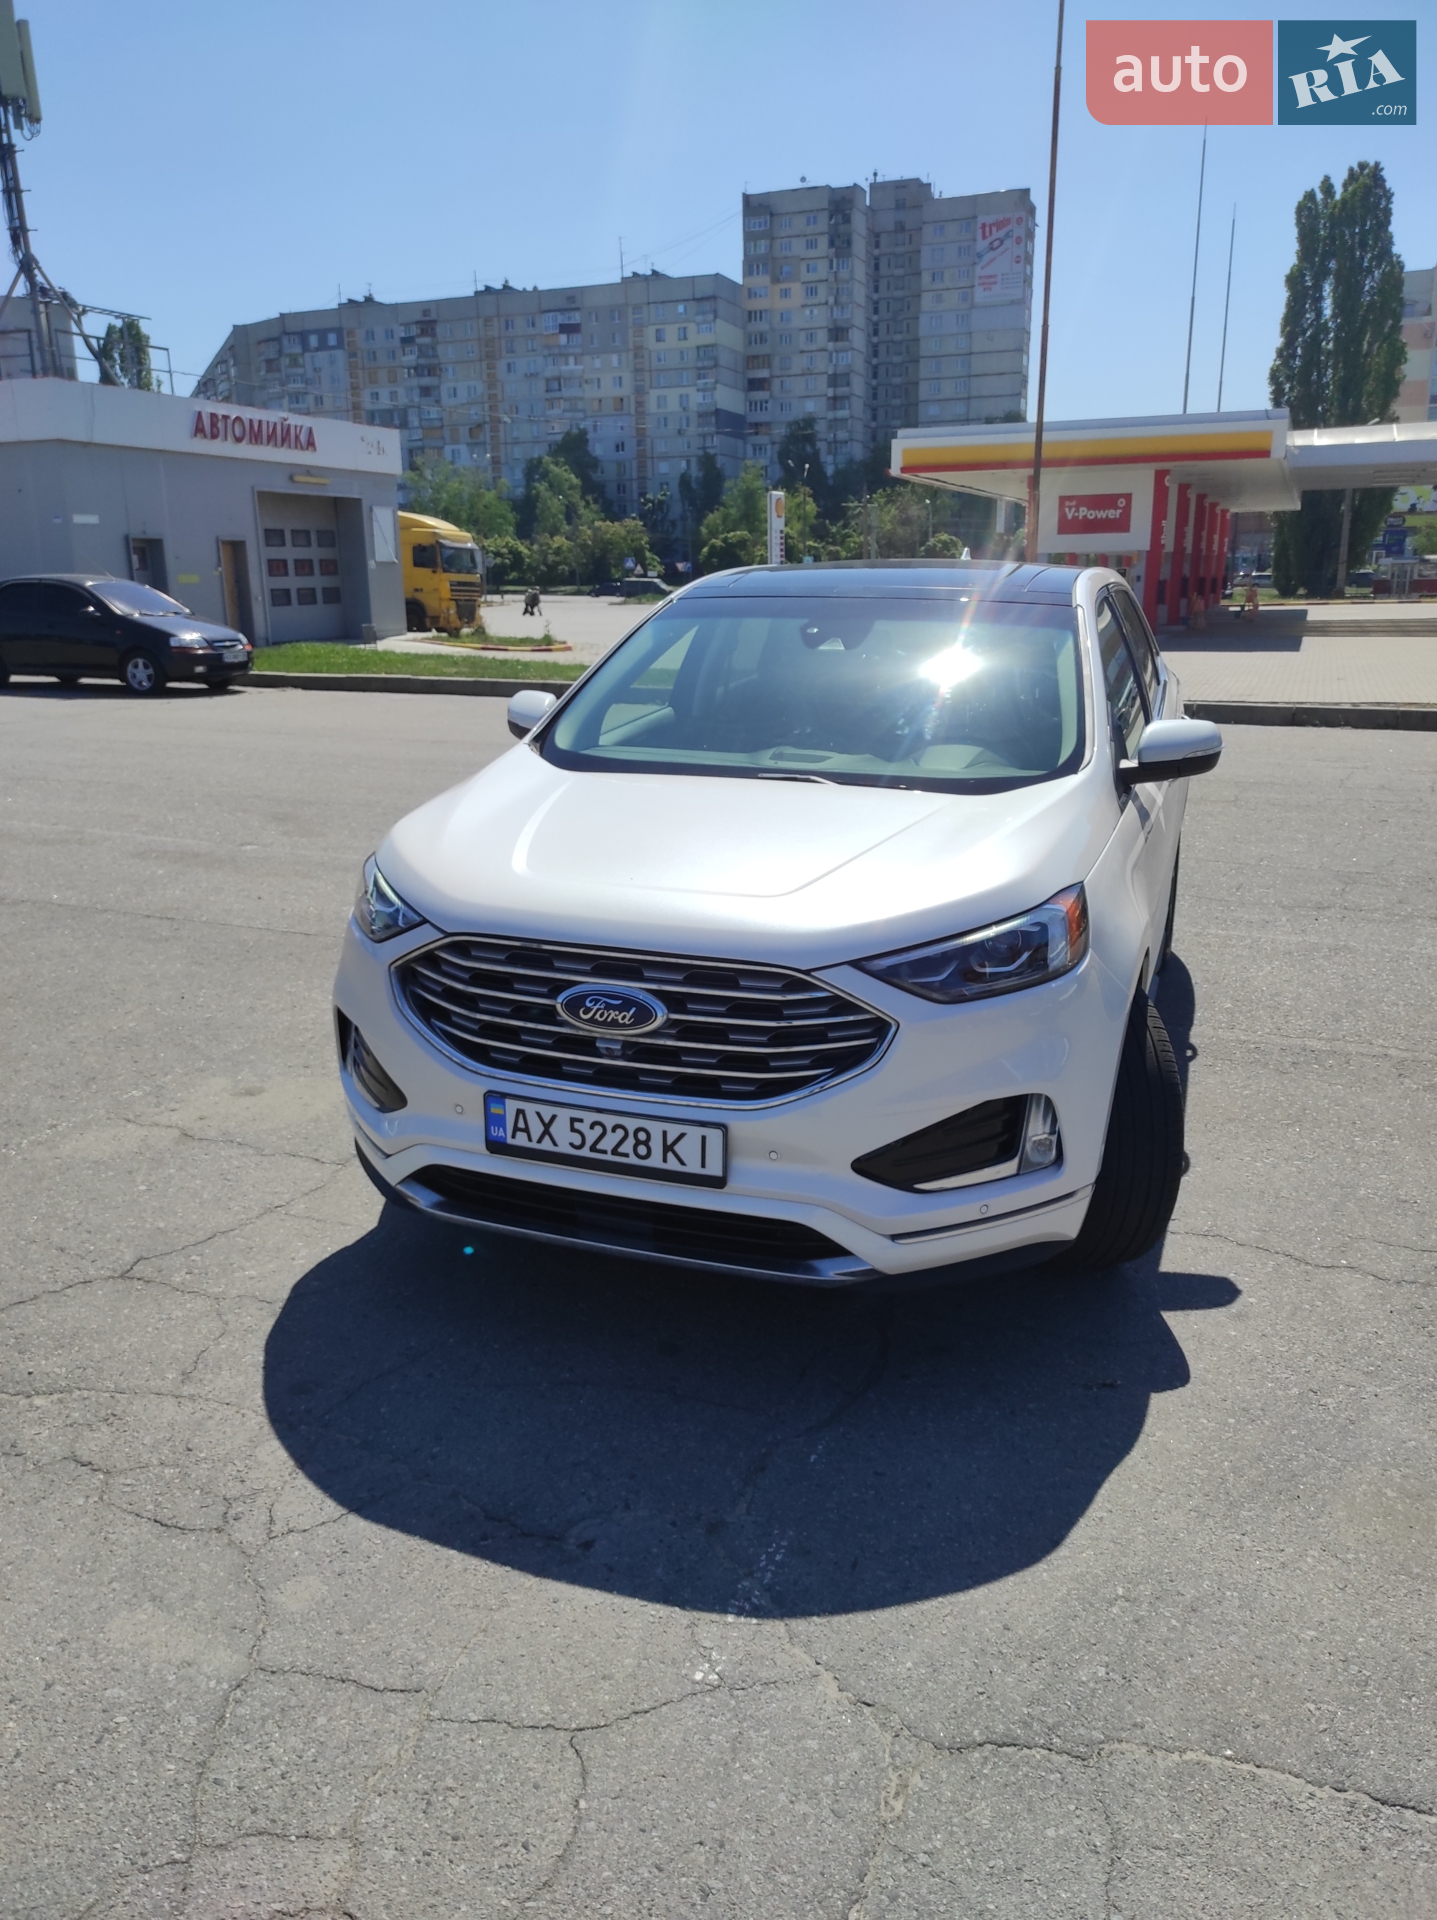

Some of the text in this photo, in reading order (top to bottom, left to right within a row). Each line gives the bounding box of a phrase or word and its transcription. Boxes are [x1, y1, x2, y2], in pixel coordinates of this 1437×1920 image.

[192, 410, 318, 452] АВТОМИЙКА
[1064, 506, 1123, 520] V-Power
[579, 995, 637, 1025] Ford
[490, 1125, 506, 1138] UA
[511, 1107, 707, 1169] AX 5228 KI
